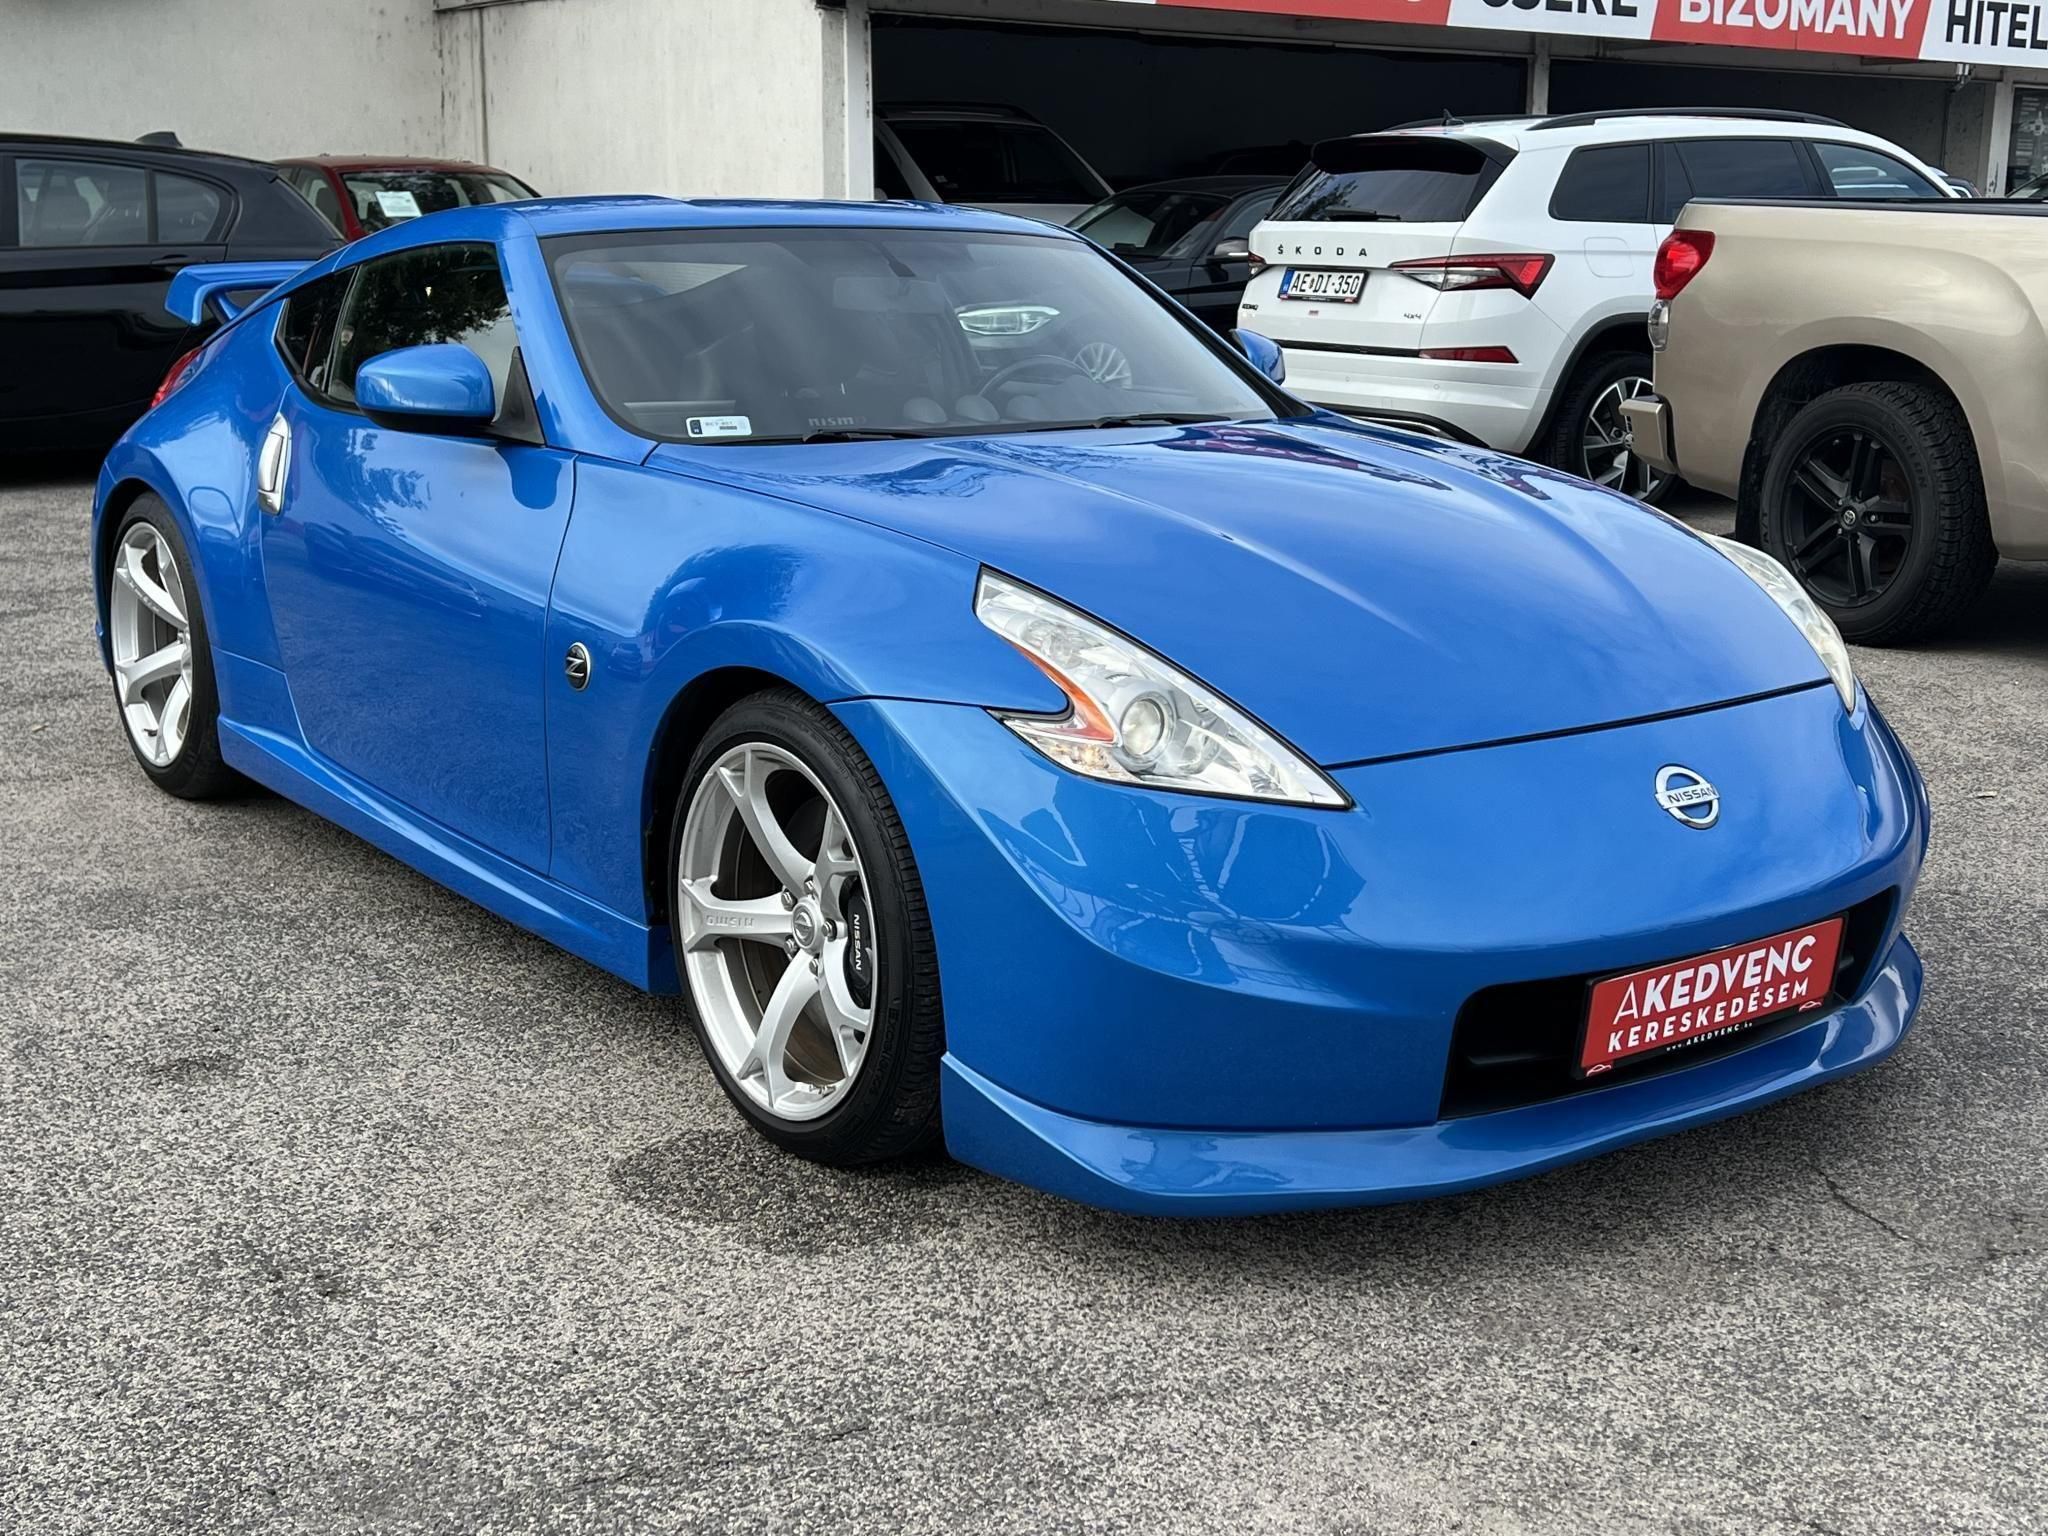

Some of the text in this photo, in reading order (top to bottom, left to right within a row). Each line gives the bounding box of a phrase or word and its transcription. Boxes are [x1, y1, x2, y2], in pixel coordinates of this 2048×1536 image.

[1278, 244, 1368, 257] ŠKODA
[1667, 787, 1717, 803] NISSAN
[853, 914, 863, 971] NISSAN
[1607, 977, 1810, 1053] KERESKEDÉSEM
